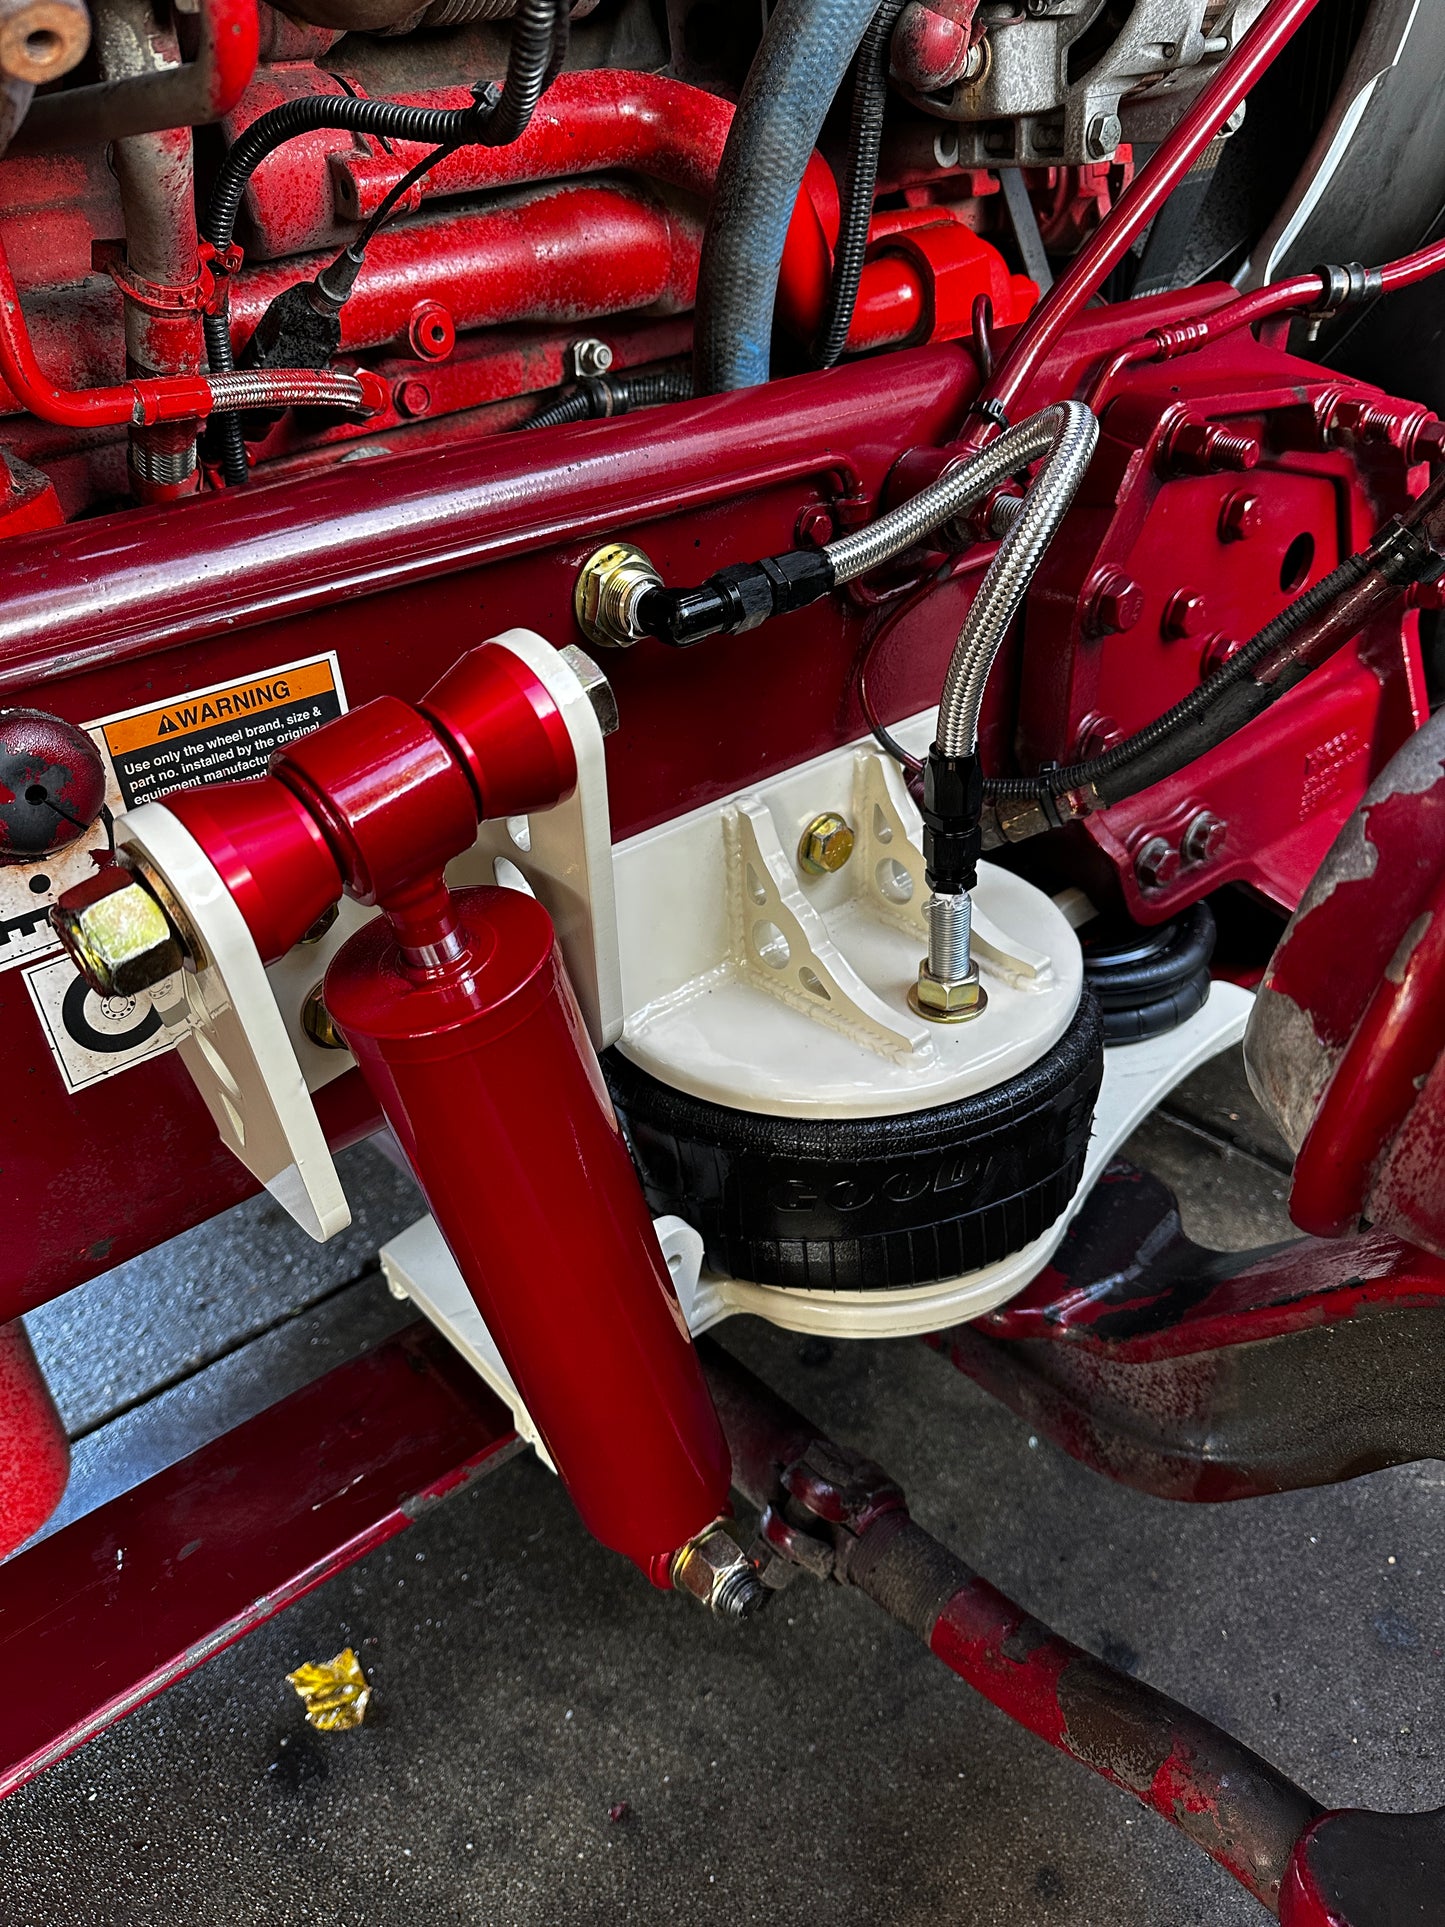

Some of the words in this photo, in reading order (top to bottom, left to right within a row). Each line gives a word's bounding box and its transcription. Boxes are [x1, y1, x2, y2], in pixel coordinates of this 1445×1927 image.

[175, 681, 291, 728] WARNING
[124, 760, 151, 775] Use
[153, 750, 181, 766] only
[183, 743, 205, 757] the
[206, 729, 243, 750] wheel
[244, 718, 285, 738] brand,
[286, 711, 311, 725] size
[312, 706, 322, 717] &
[129, 773, 156, 793] part
[158, 768, 180, 781] no.
[181, 748, 235, 774] installed
[236, 744, 252, 757] by
[254, 737, 275, 751] the
[276, 721, 320, 744] original
[133, 775, 202, 805] equipment
